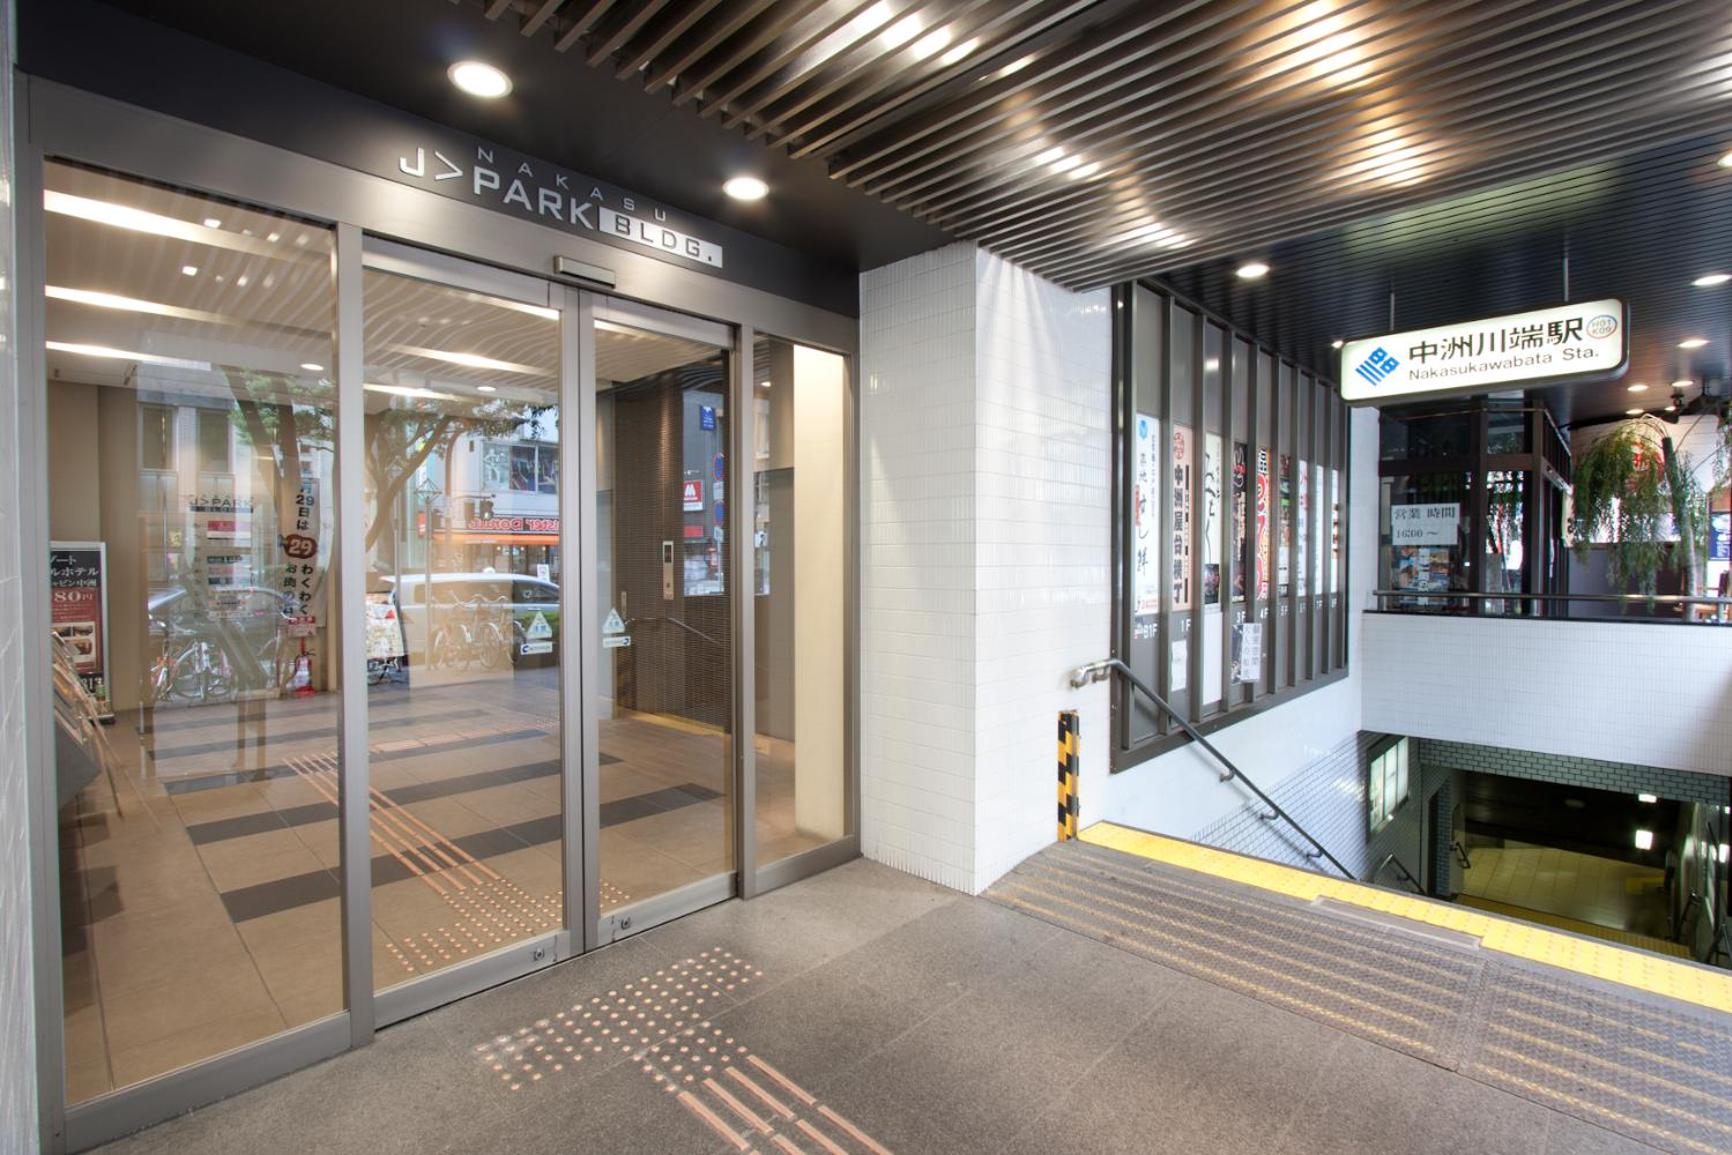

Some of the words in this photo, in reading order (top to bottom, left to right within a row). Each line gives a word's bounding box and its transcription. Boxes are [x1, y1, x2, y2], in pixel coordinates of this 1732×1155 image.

[477, 146, 667, 222] NAKASU
[614, 213, 714, 263] BLDG.
[1408, 316, 1584, 365] 中洲川端駅
[1408, 353, 1554, 382] Nakasukawabata
[1561, 347, 1600, 362] Sta.
[299, 563, 314, 615] わくわく
